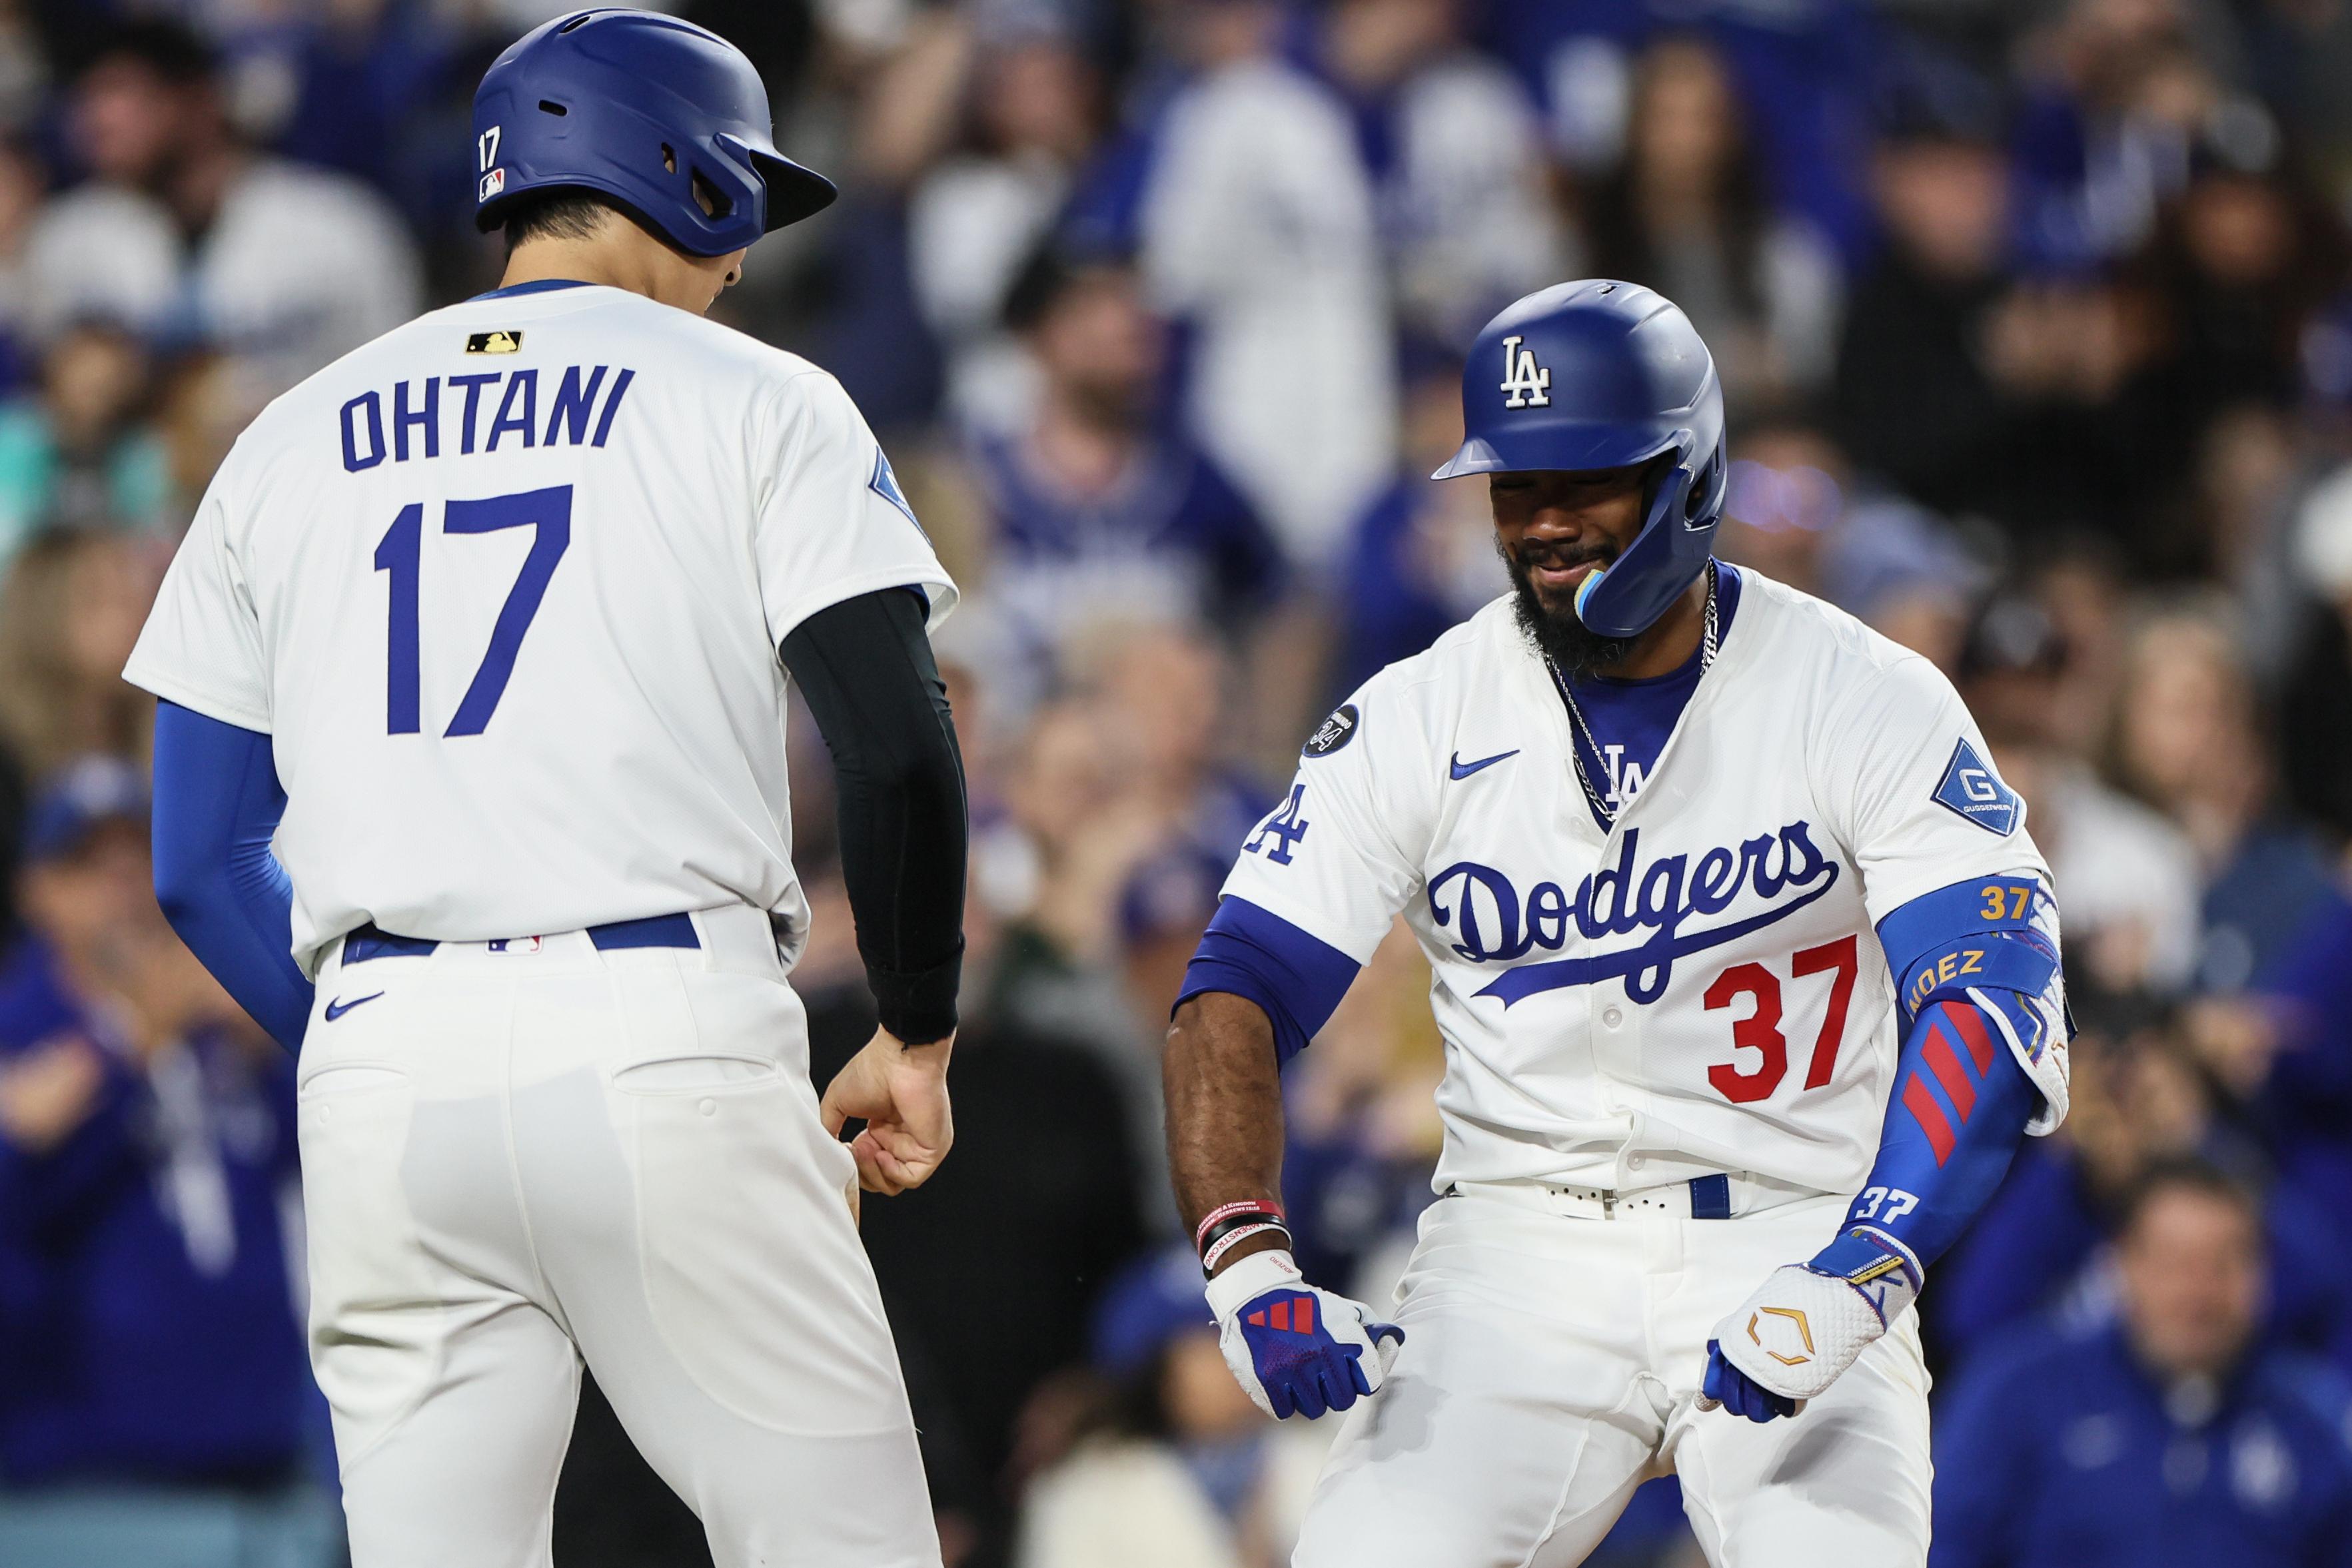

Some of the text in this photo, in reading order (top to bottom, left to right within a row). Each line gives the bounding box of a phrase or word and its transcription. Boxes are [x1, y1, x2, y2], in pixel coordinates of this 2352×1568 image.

[478, 125, 500, 173] 17
[1500, 336, 1550, 409] LA
[340, 366, 636, 473] OHTANI
[374, 484, 573, 738] 17
[1310, 721, 1343, 751] 34
[1604, 745, 1644, 816] LA
[1959, 769, 1997, 801] G
[1242, 784, 1309, 866] LA
[1428, 820, 1840, 1005] Dodgers
[1980, 886, 2030, 920] 37
[1703, 934, 1858, 1103] 37
[1908, 950, 1984, 1023] NDEZ
[1855, 1186, 1920, 1224] 37
